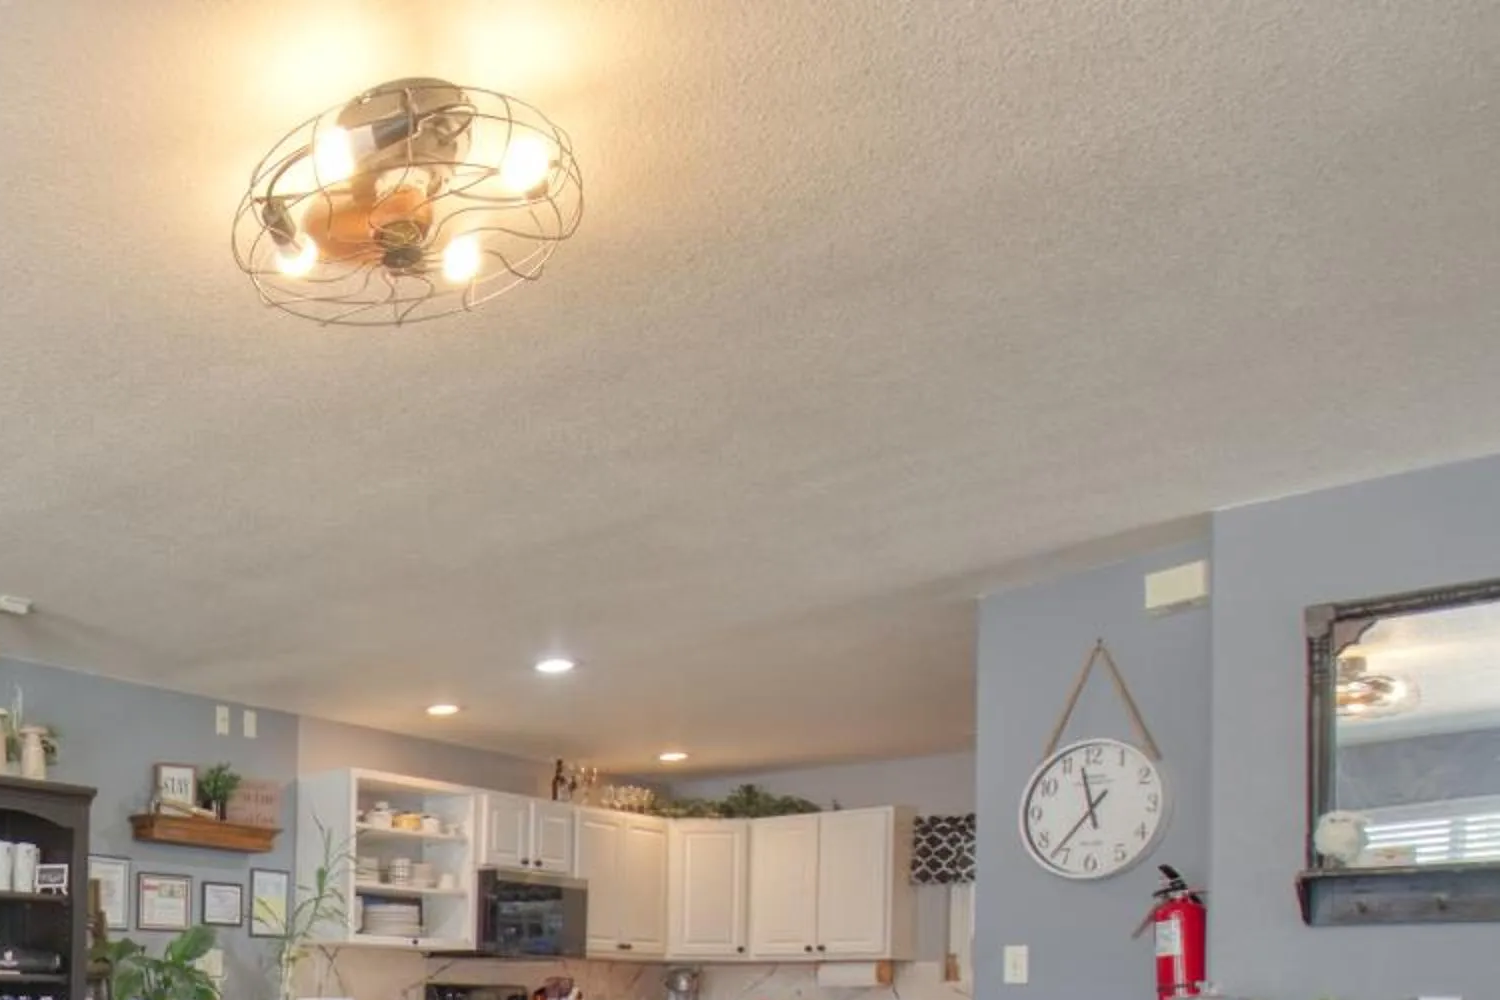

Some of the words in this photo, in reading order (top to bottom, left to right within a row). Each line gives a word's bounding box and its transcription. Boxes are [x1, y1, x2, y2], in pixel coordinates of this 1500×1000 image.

[1085, 748, 1103, 764] 12
[1117, 749, 1125, 767] 1
[1063, 757, 1073, 774] 11
[1139, 767, 1151, 785] 2
[1041, 778, 1058, 797] 10
[1031, 806, 1043, 821] 9
[1038, 831, 1049, 849] 8
[1060, 848, 1071, 865] 7
[1114, 843, 1126, 862] 5
[1083, 854, 1098, 872] 6
